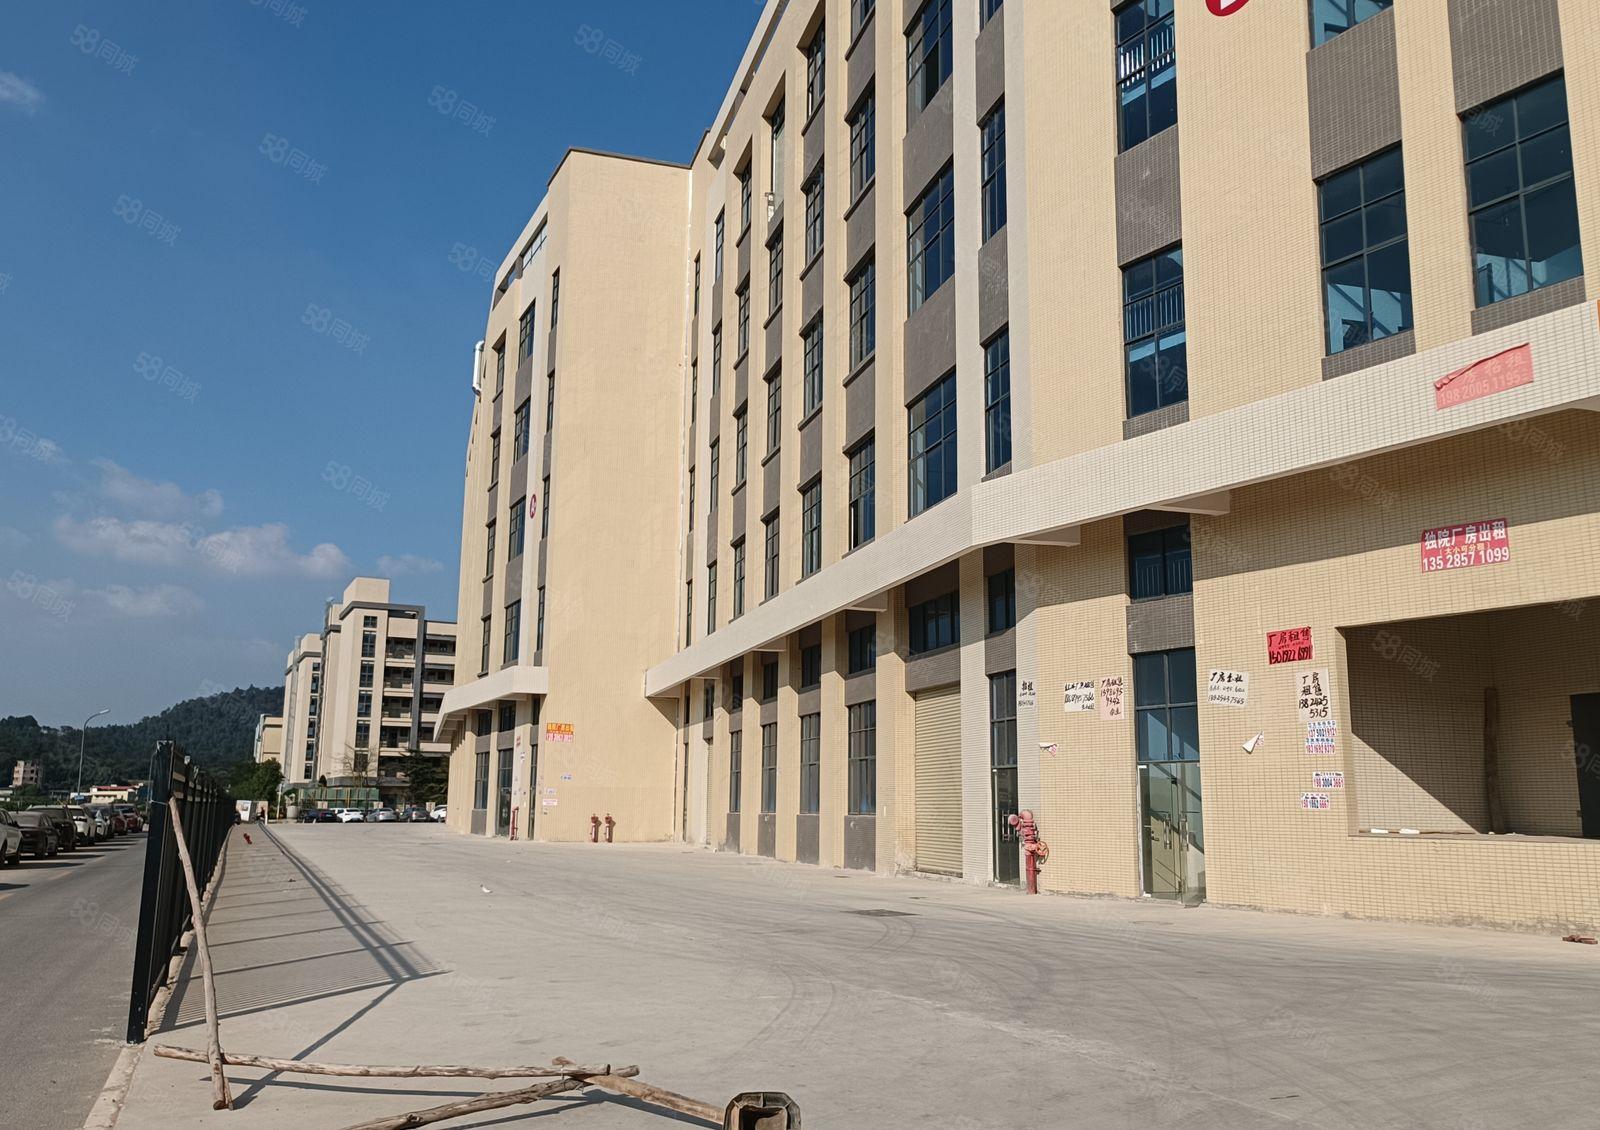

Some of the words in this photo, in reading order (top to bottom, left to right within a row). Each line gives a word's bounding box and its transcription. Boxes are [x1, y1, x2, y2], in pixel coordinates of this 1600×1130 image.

[1424, 521, 1507, 551] 独院厂房出租
[1422, 556, 1444, 572] 135
[1446, 551, 1475, 569] 2857
[1479, 546, 1510, 564] 1099
[1268, 626, 1312, 648] 厂房租售
